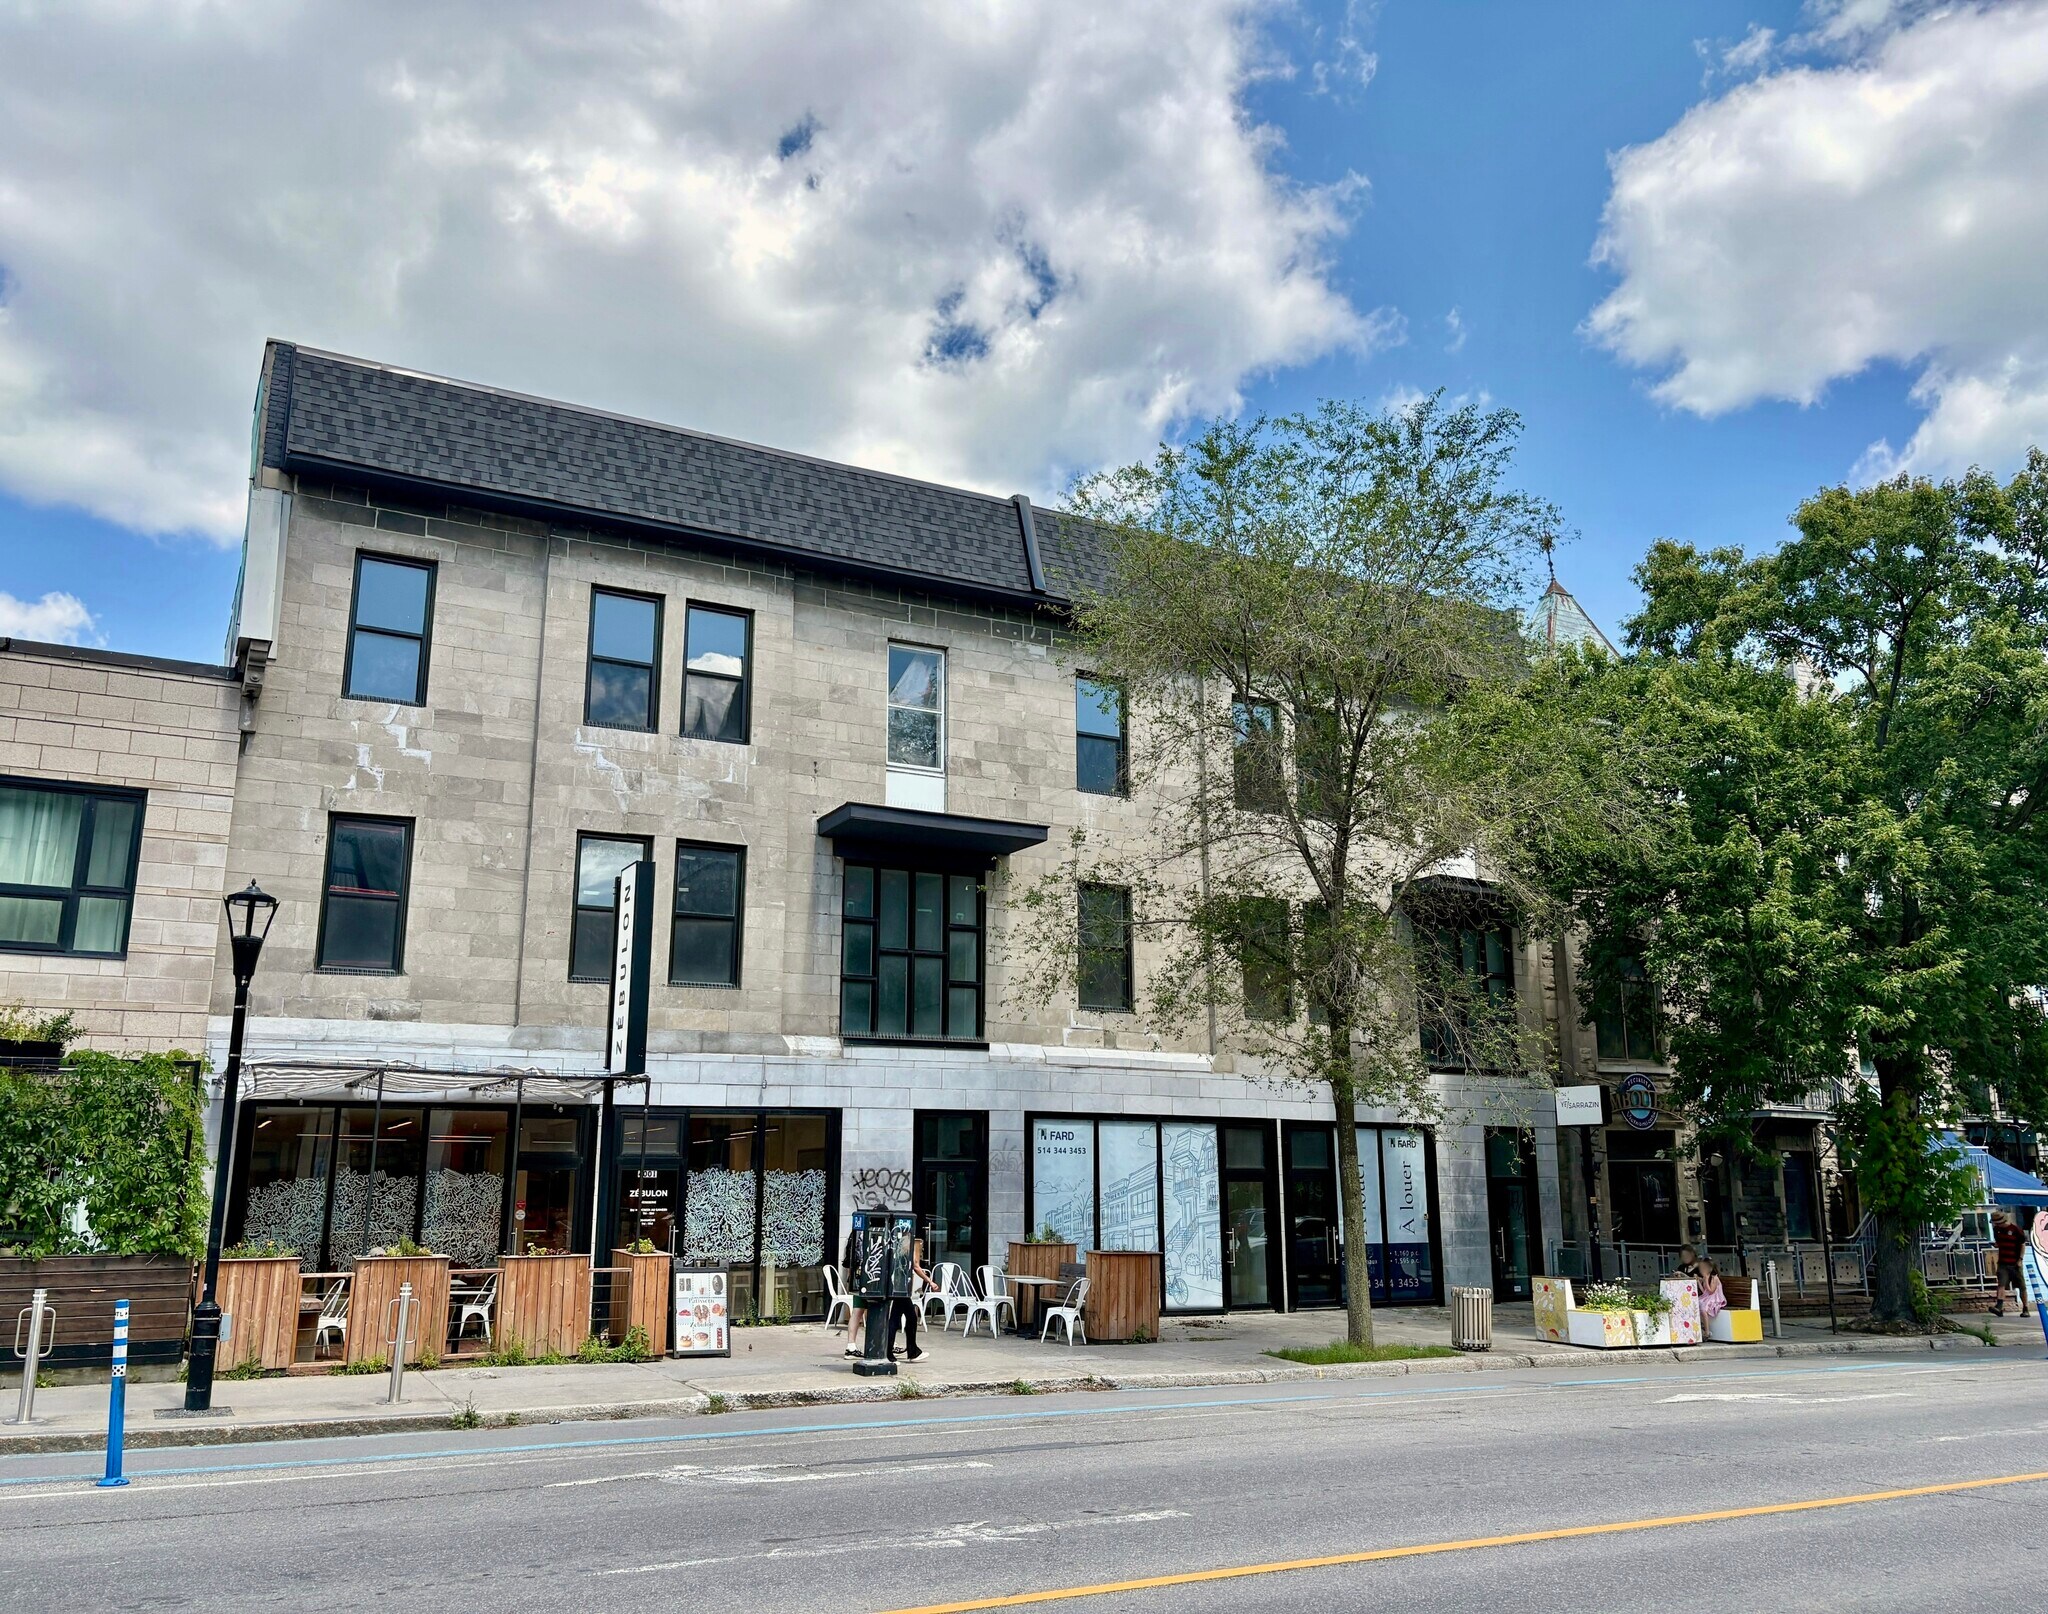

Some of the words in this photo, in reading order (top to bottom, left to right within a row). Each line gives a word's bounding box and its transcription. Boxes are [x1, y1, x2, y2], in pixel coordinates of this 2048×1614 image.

[1050, 1131, 1075, 1141] FARD
[1397, 1140, 1417, 1149] FARD
[1400, 1161, 1414, 1210] louer
[629, 1188, 668, 1198] ZÉBULON
[1398, 1278, 1420, 1288] 3453
